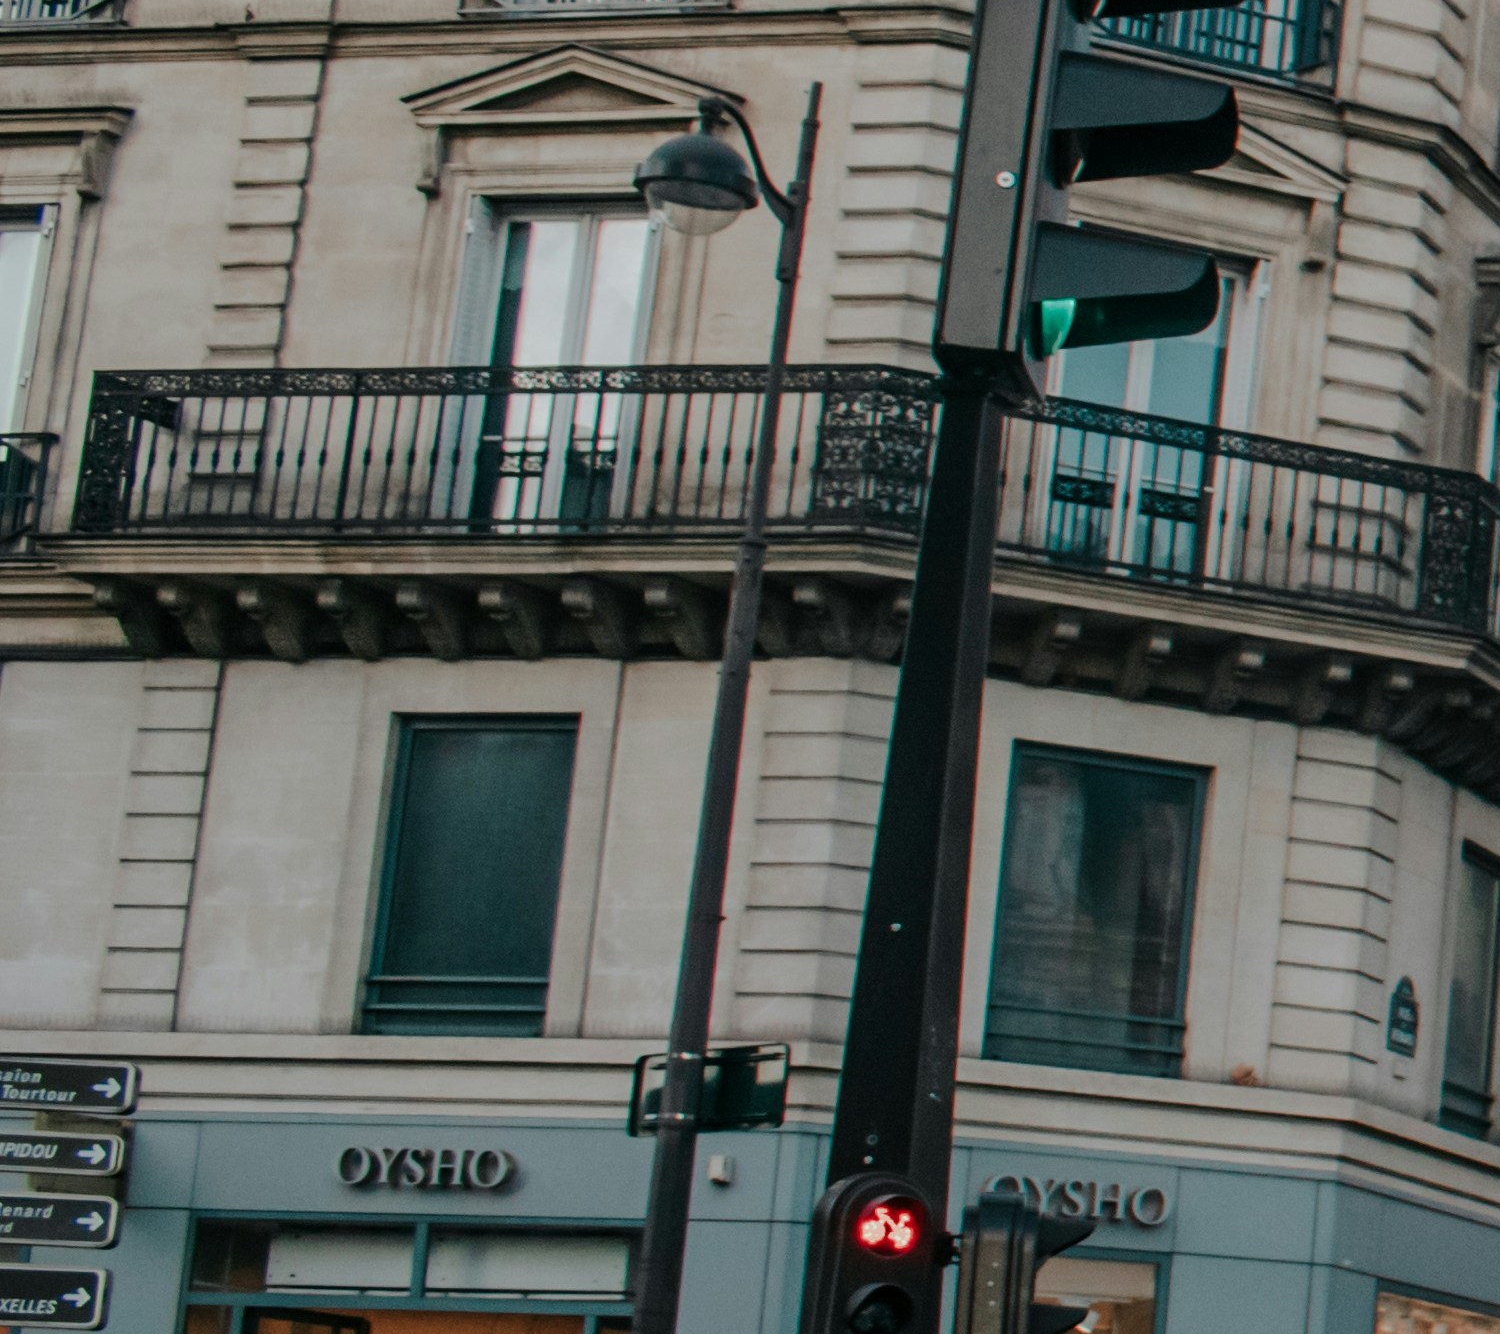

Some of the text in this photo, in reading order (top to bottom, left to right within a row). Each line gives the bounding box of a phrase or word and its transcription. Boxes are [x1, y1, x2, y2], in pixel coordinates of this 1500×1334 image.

[3, 1084, 77, 1102] Tourtour
[338, 1147, 509, 1188] OYSHO
[0, 1201, 54, 1219] enard
[0, 1297, 58, 1315] XELLES
